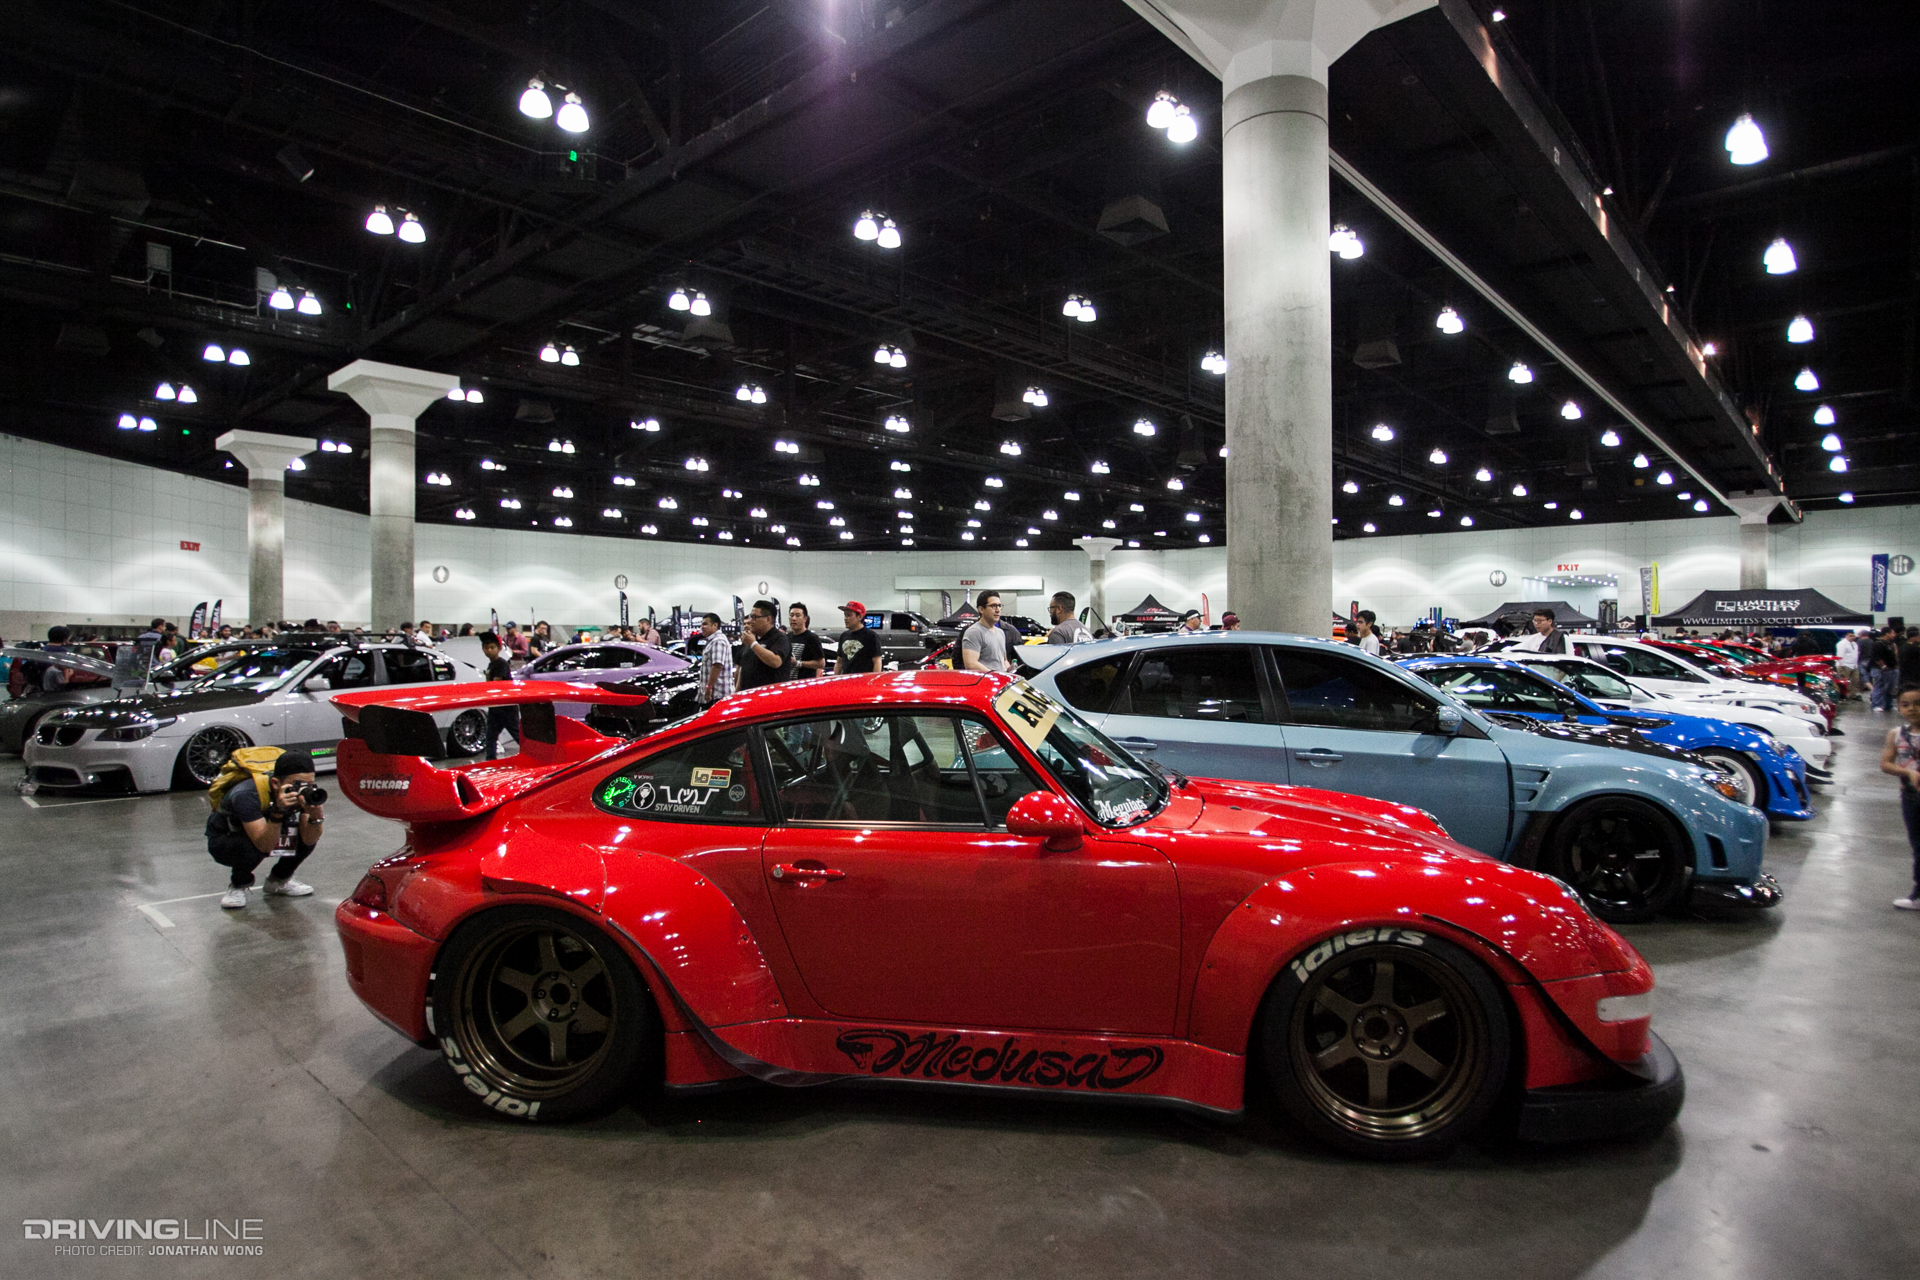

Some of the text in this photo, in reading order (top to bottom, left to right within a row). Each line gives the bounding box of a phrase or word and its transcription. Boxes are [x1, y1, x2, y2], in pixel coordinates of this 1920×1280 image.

[359, 779, 410, 790] STICKARS
[654, 803, 700, 813] STAY DRIVEN
[1291, 928, 1427, 983] idlers
[836, 1028, 1164, 1089] Medusa
